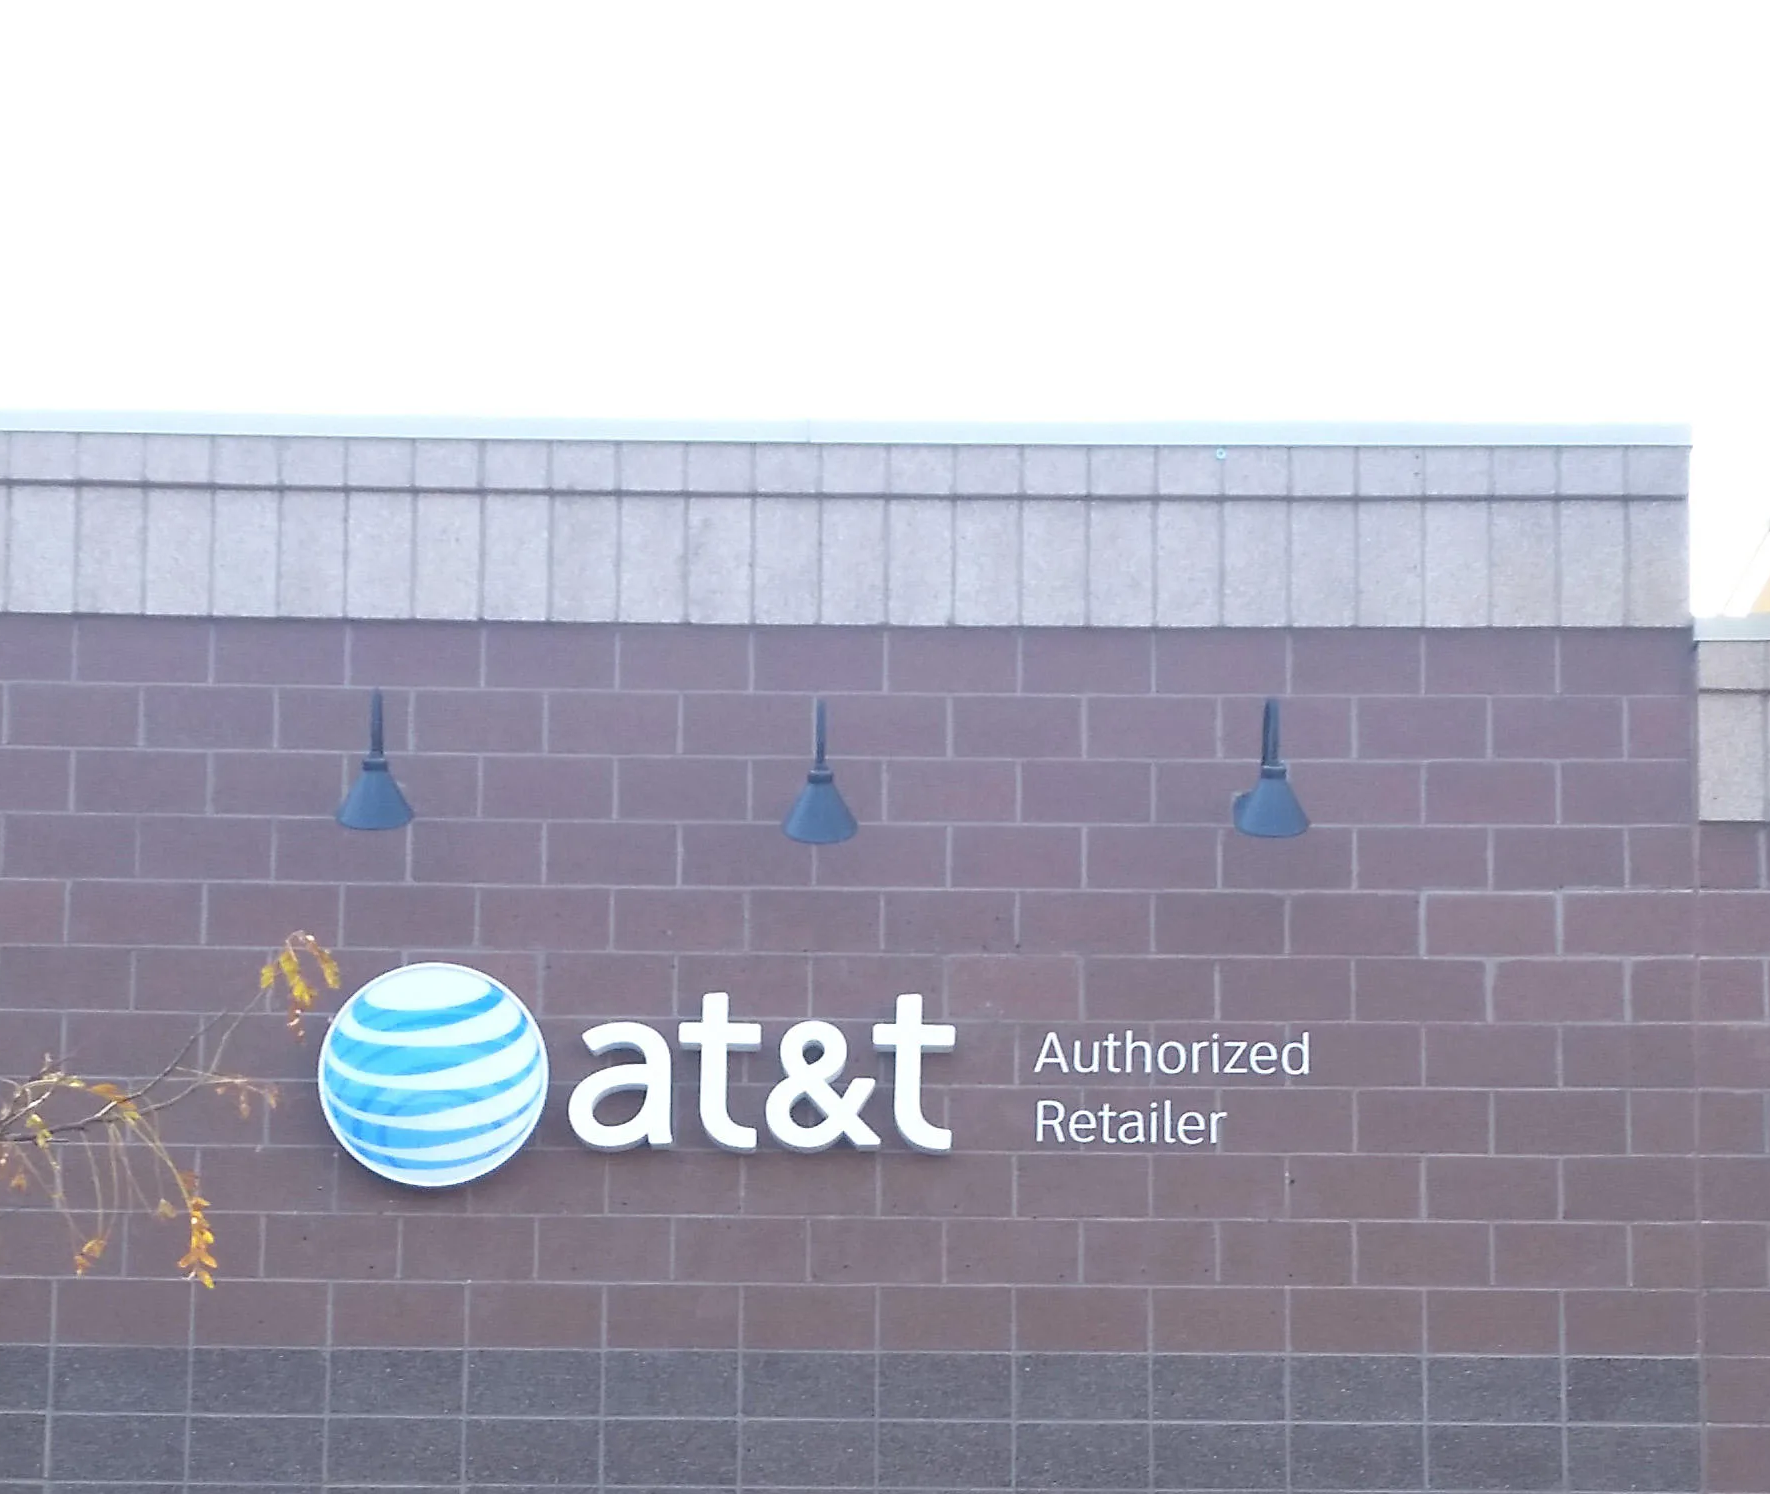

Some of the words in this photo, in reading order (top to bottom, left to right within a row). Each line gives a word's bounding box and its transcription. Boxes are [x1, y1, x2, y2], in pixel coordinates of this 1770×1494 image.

[566, 991, 955, 1155] at&t
[1035, 1031, 1311, 1076] Authorized
[1036, 1100, 1227, 1144] Retailer
